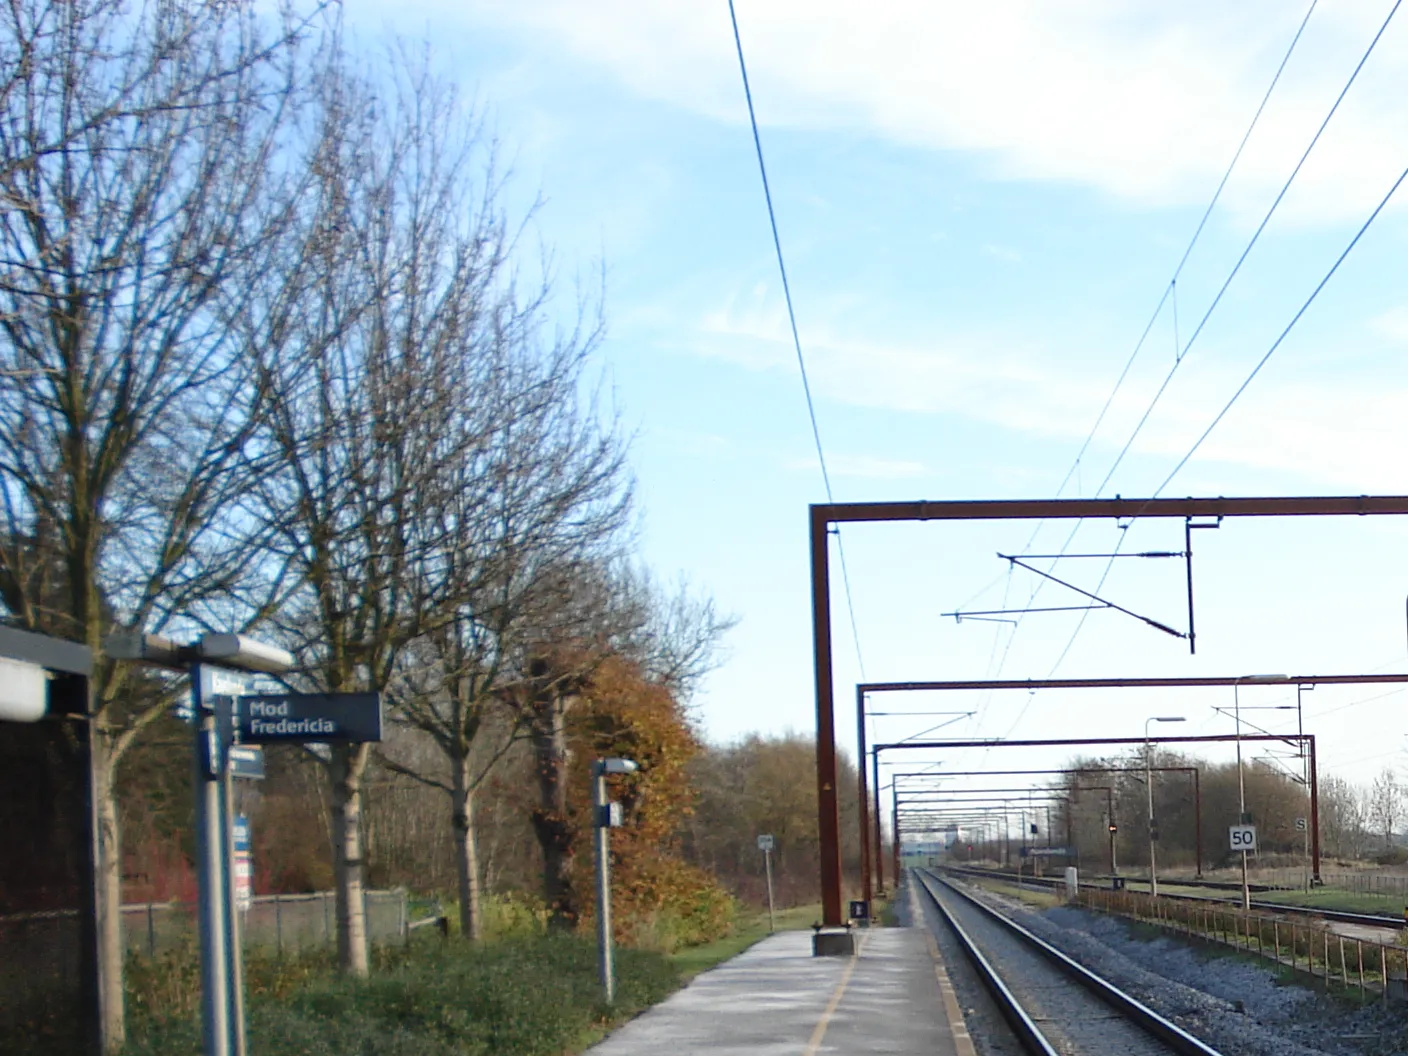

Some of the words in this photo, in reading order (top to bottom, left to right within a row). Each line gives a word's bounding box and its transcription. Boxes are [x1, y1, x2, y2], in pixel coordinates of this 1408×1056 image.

[249, 701, 288, 716] Mod
[251, 718, 335, 734] Fredericia
[1232, 831, 1253, 845] 50
